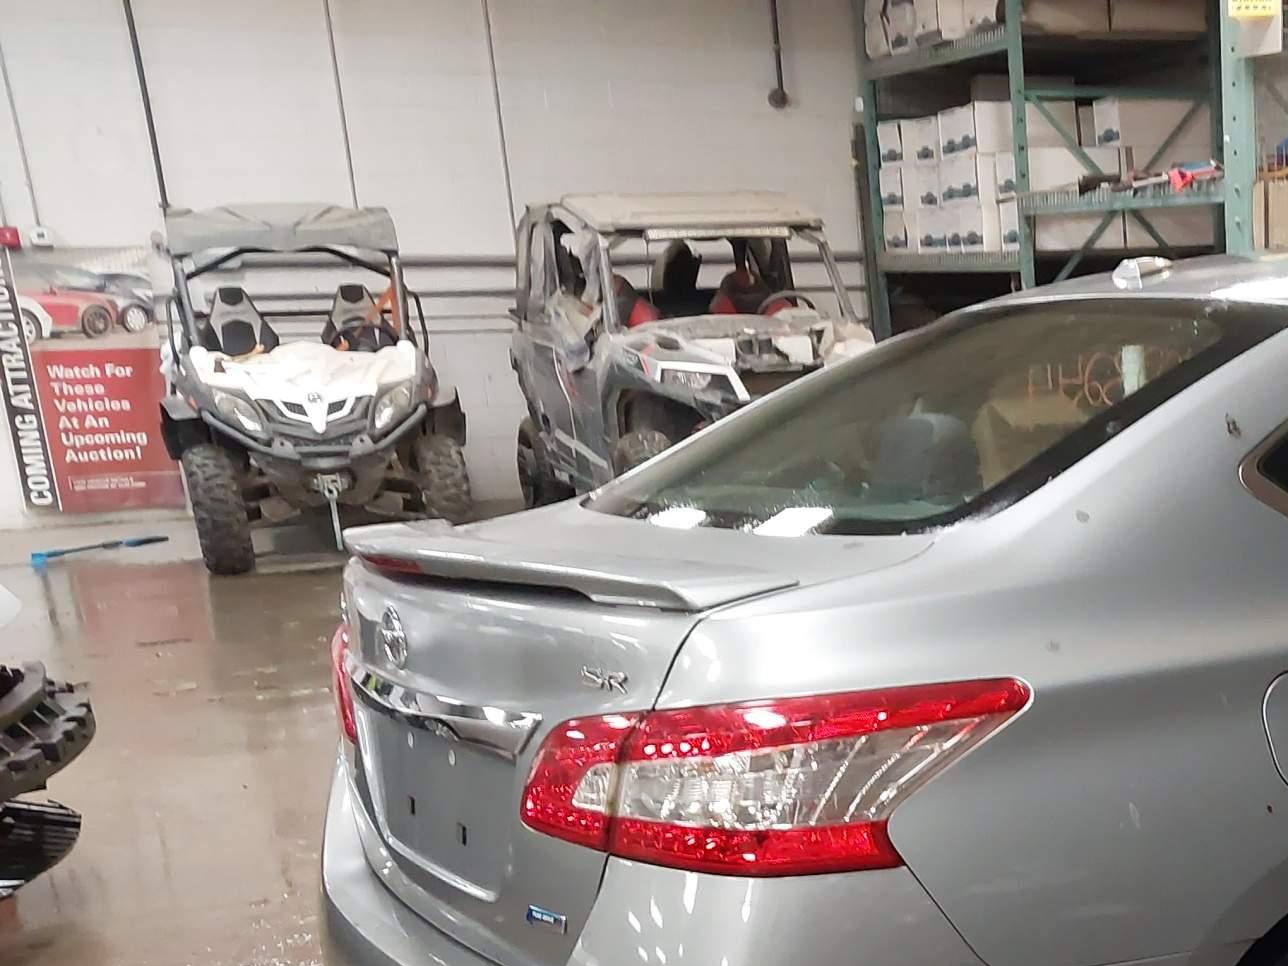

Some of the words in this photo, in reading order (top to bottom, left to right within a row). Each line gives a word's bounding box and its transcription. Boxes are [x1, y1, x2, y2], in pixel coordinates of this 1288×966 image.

[47, 363, 100, 379] Watch
[105, 363, 133, 377] For
[50, 382, 104, 396] These
[54, 398, 131, 413] Vehicles
[59, 415, 79, 430] At
[85, 414, 110, 429] An
[61, 430, 148, 448] Upcoming
[15, 414, 53, 507] COMING
[65, 446, 142, 464] Auction!
[580, 665, 627, 694] SR
